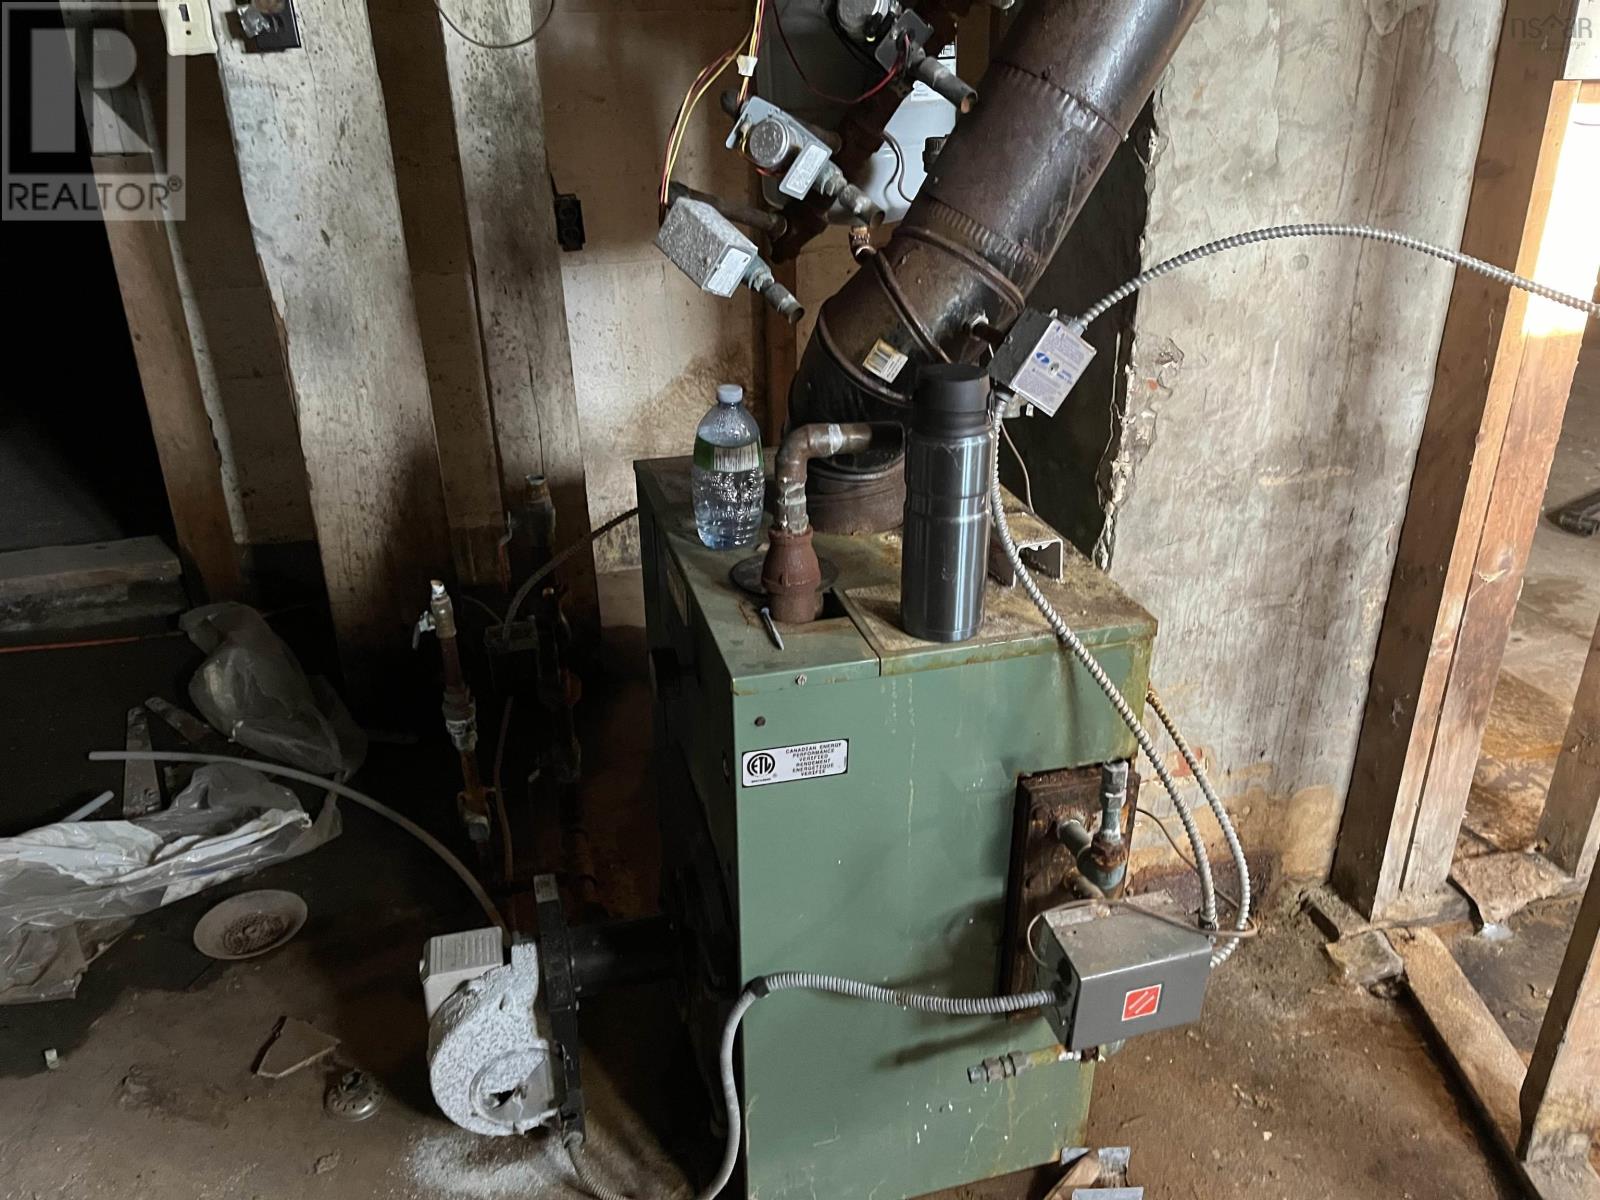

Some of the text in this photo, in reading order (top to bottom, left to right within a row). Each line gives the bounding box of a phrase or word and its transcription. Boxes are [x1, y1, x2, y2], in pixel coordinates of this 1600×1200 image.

[786, 746, 817, 754] CANADIAN
[792, 748, 834, 757] PERFORMANCE
[751, 757, 771, 774] ETL
